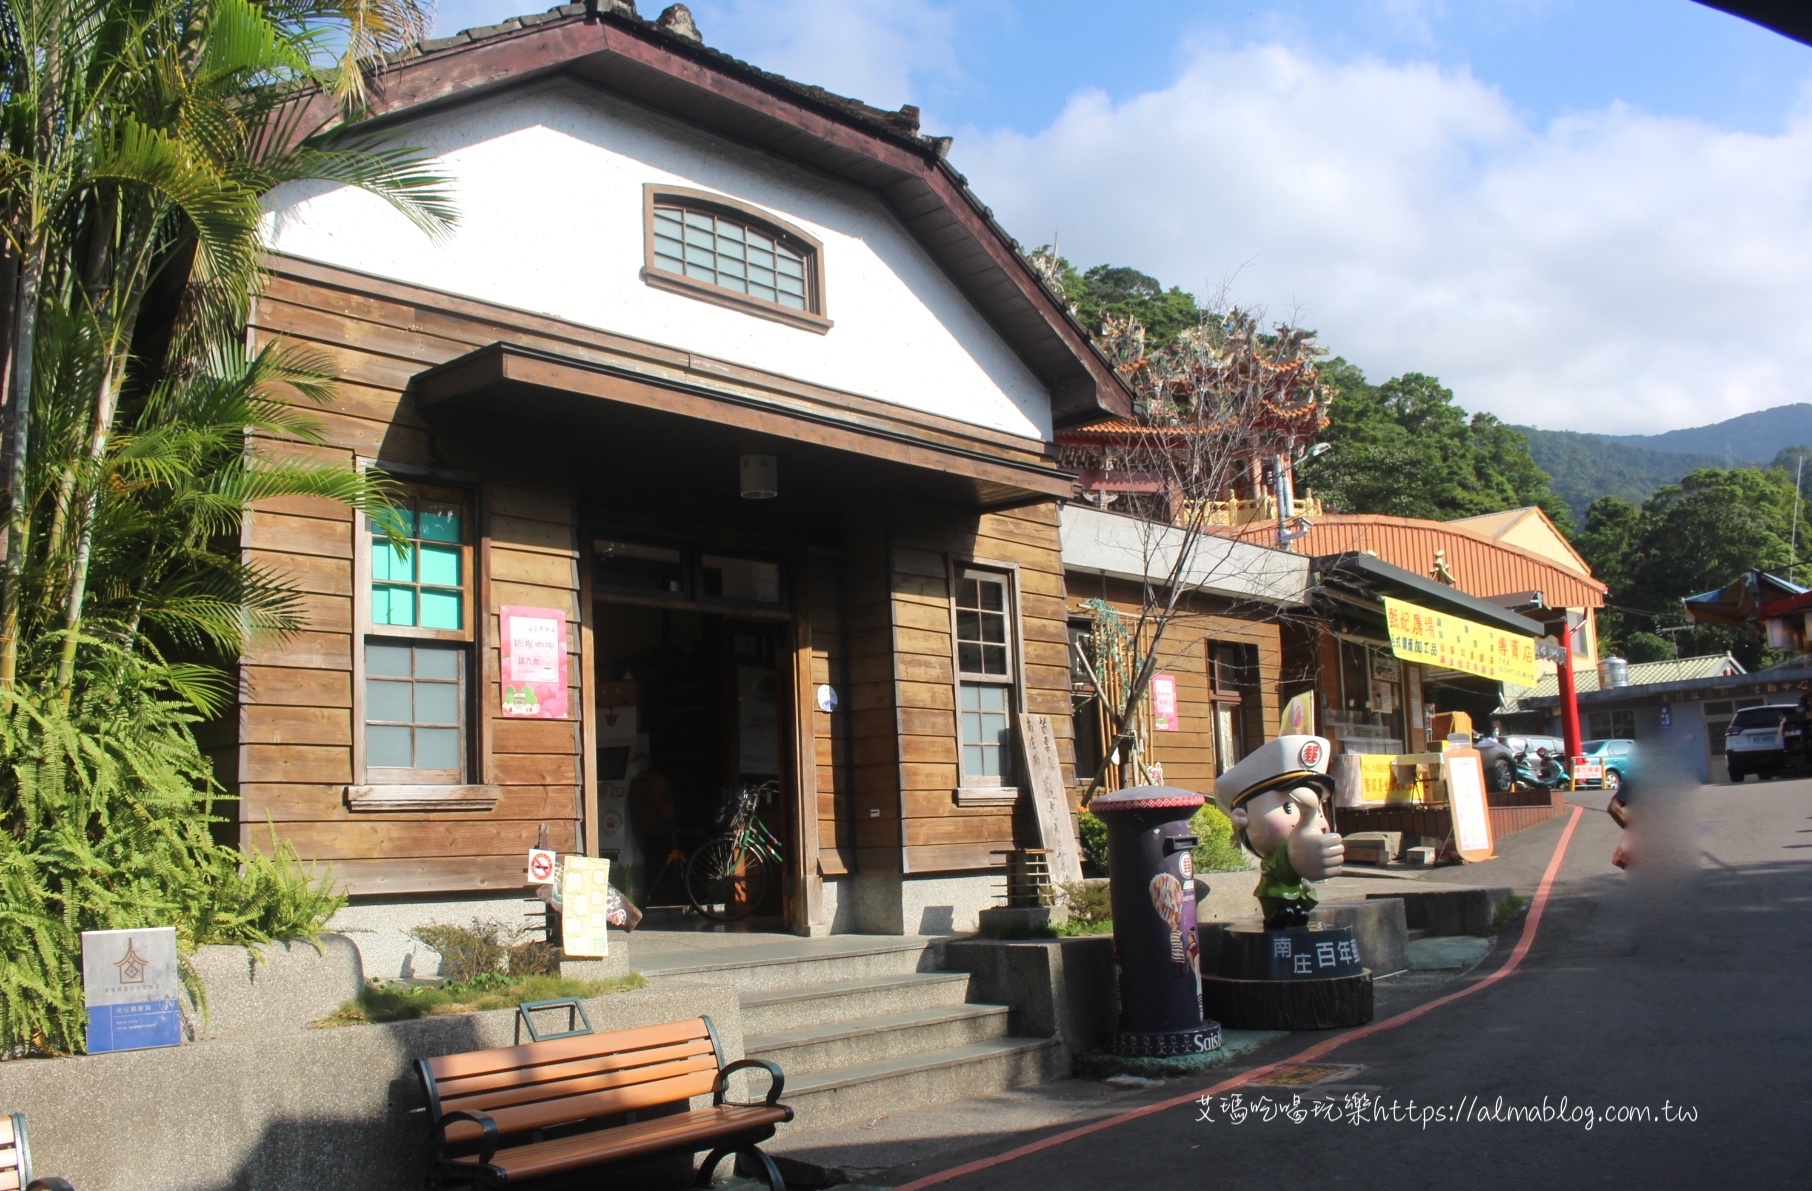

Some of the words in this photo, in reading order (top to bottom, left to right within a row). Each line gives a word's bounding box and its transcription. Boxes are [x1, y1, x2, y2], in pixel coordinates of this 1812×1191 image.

[1498, 636, 1533, 664] 專賣店
[1304, 745, 1320, 764] 郵
